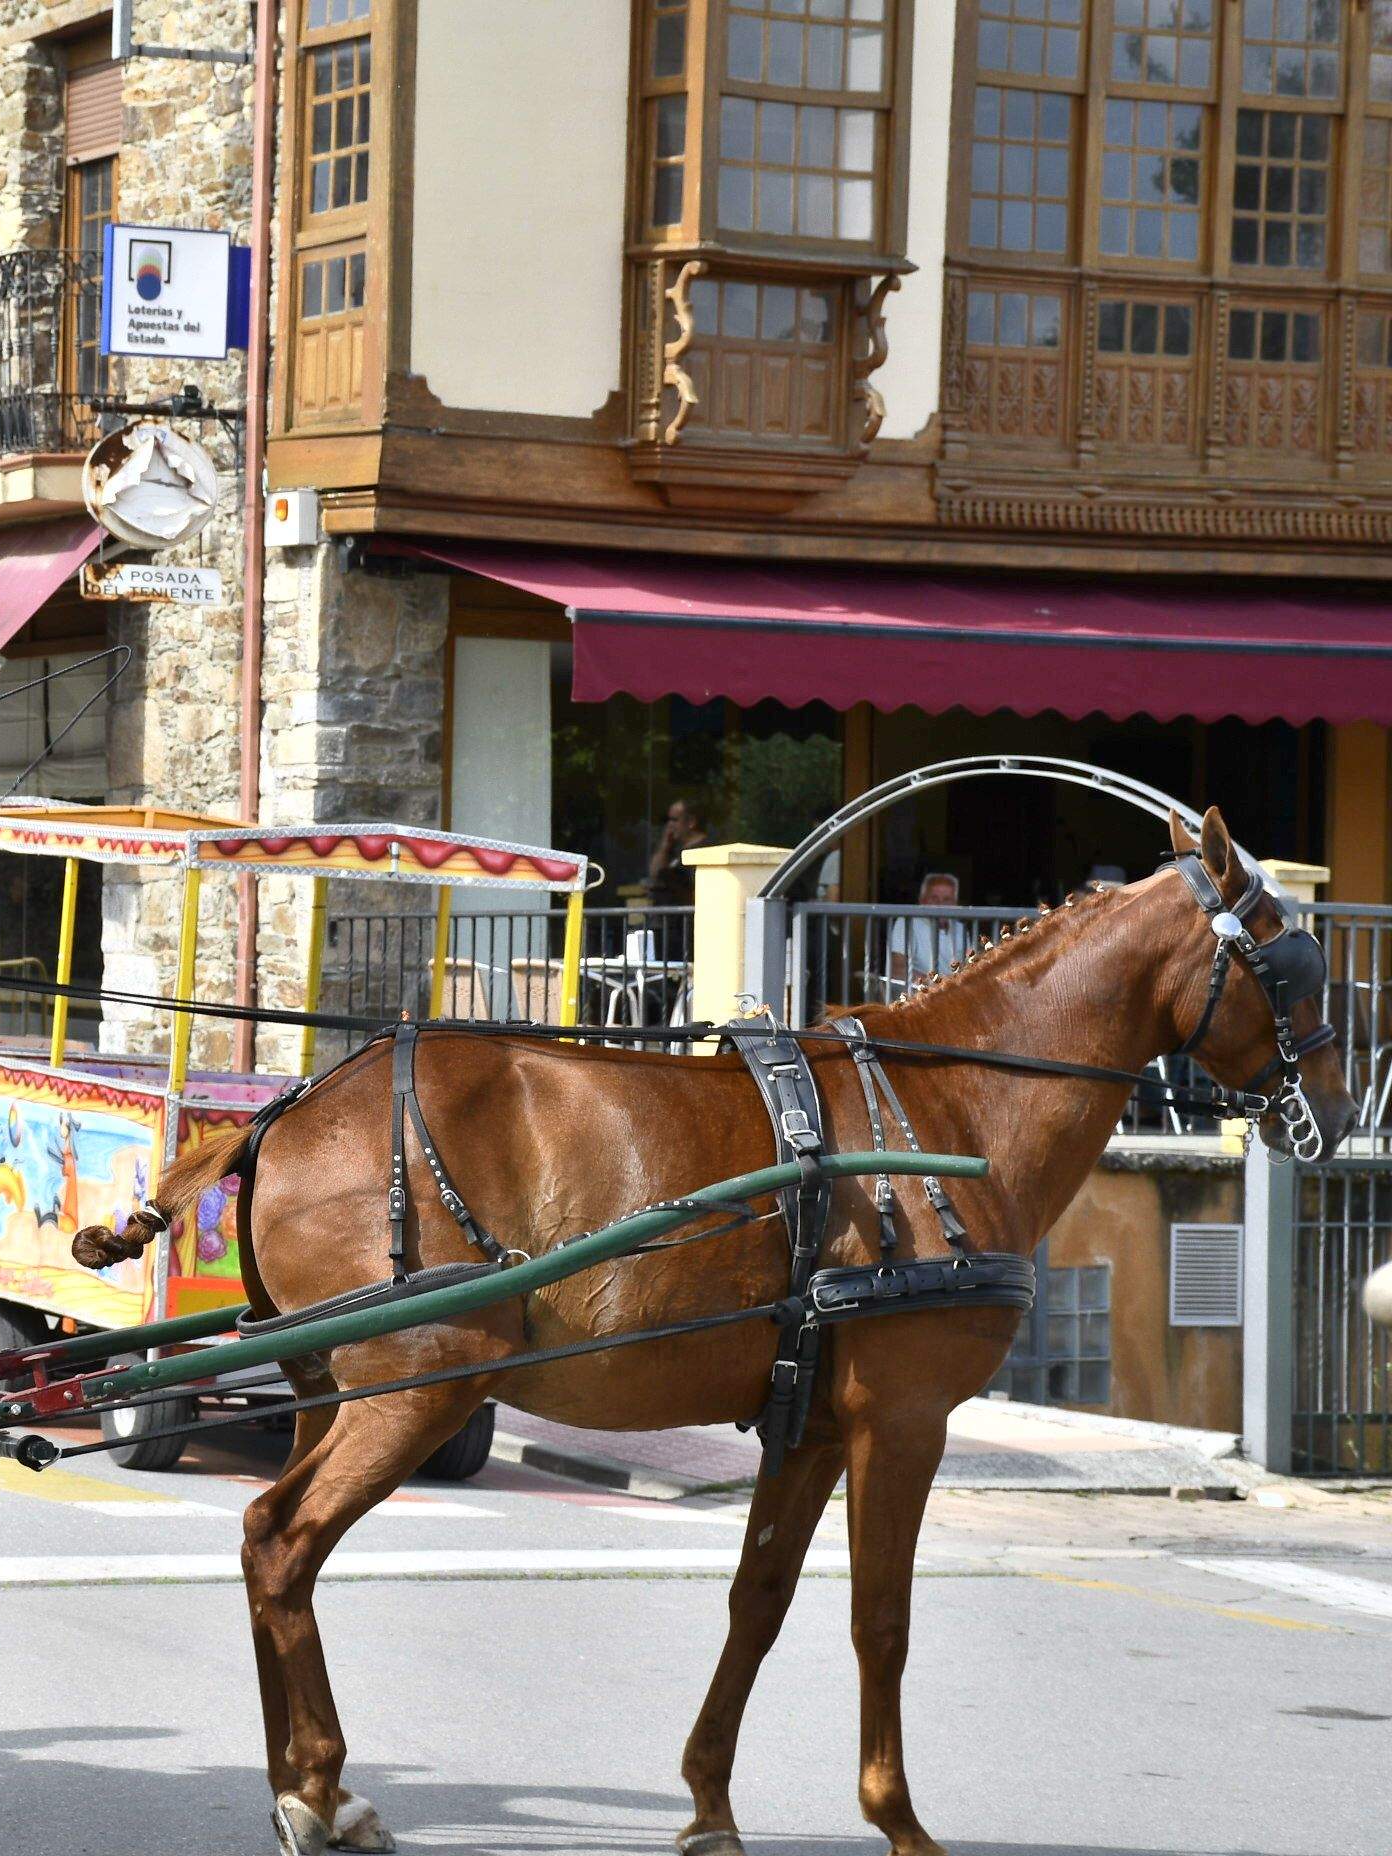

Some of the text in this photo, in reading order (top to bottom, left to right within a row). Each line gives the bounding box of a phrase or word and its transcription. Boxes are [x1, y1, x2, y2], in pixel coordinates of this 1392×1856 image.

[176, 309, 183, 320] y
[128, 318, 200, 333] Apuestas del
[127, 333, 165, 345] Estado
[131, 571, 201, 585] POSADA
[91, 584, 214, 600] DEL TENIENTE
